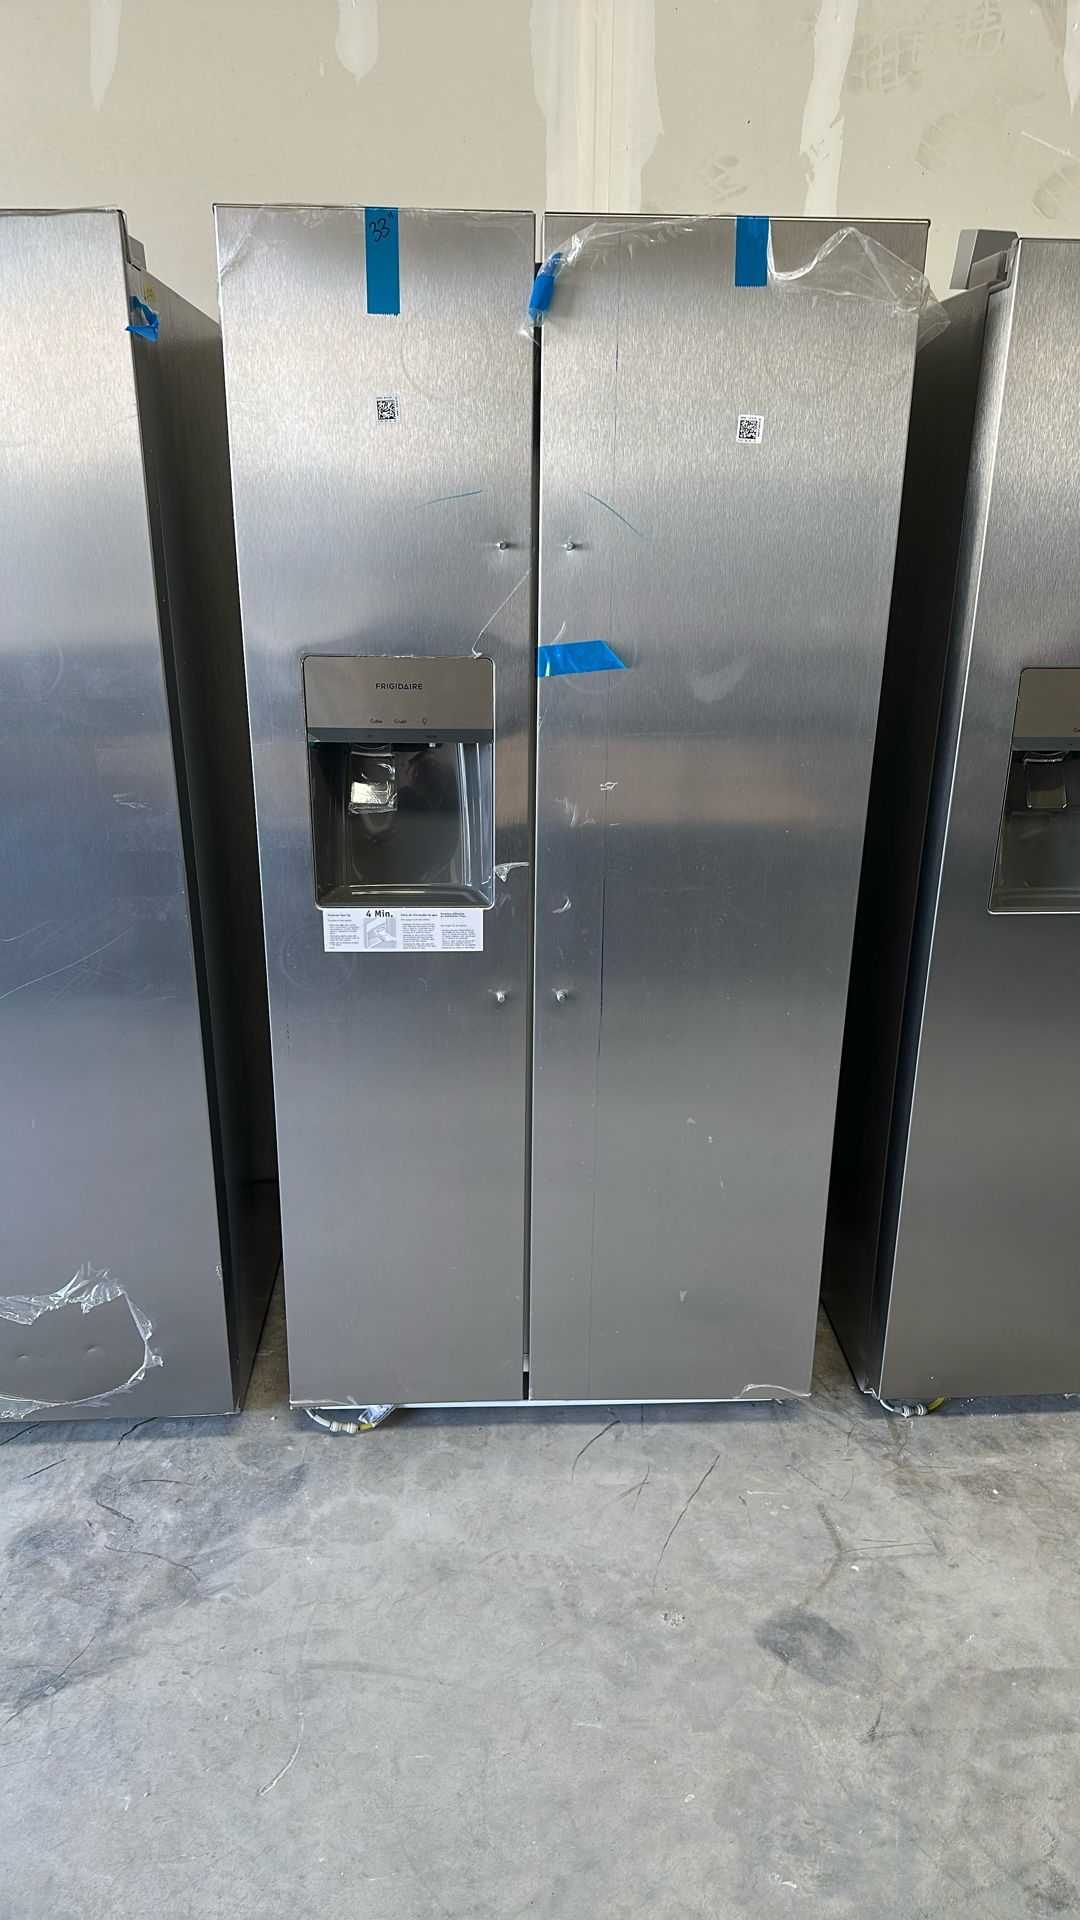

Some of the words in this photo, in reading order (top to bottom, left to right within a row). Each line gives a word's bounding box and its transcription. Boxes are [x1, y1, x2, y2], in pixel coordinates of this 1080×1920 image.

[369, 210, 394, 242] 33"
[365, 909, 372, 918] 4
[374, 909, 394, 918] Min.
